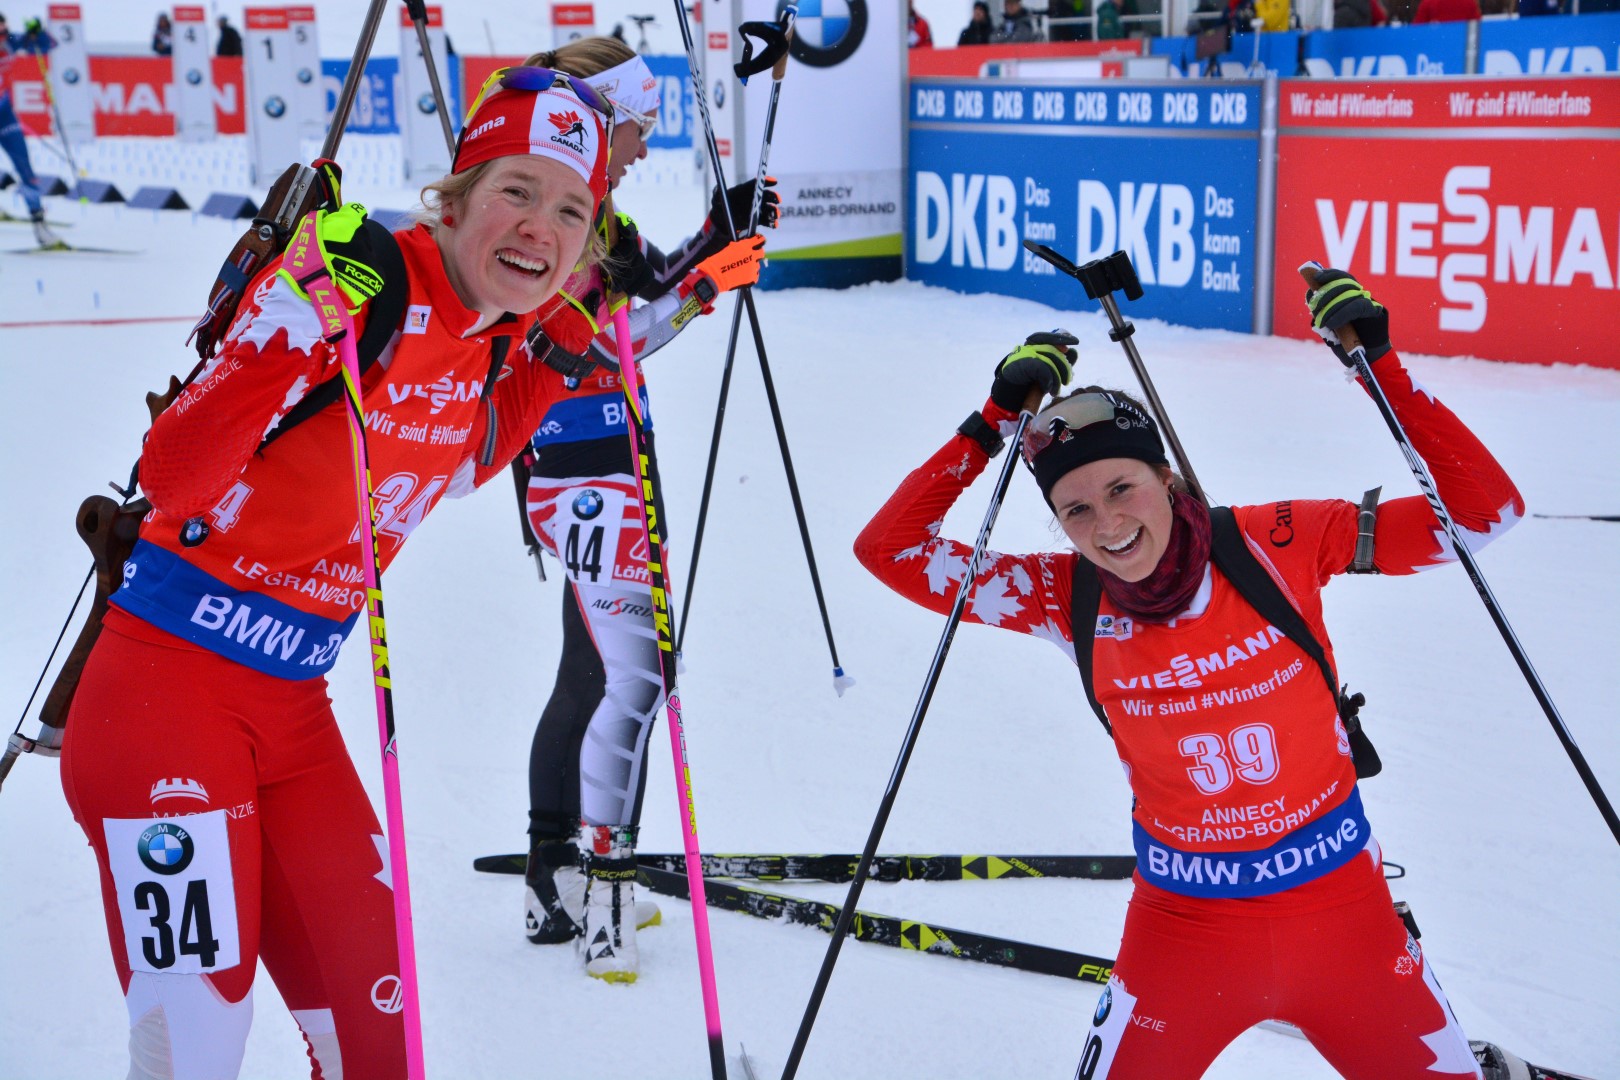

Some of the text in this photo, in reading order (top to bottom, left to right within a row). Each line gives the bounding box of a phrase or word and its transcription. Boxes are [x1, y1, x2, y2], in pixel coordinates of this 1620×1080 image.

[262, 37, 273, 60] 1
[917, 89, 1247, 124] DKB DKB DKB DKB DKB DKB DKB DKB
[1291, 93, 1413, 118] Wir sind #Winterfans
[1450, 91, 1591, 116] Wir sind #Winterfans
[550, 135, 584, 155] CANADA
[797, 186, 854, 200] ANNECY
[1024, 177, 1051, 207] Das
[1205, 185, 1234, 218] Das
[916, 170, 1018, 272] DKB
[1024, 210, 1056, 241] kann
[1077, 179, 1195, 288] DKB
[293, 218, 314, 268] LEKI
[1203, 222, 1241, 256] kann
[1315, 165, 1620, 334] VIESSMA
[720, 254, 753, 274] ziener
[1202, 261, 1241, 293] Bank
[314, 289, 342, 334] LEKI
[176, 356, 243, 417] MACKENZIE
[364, 410, 396, 436] Wir
[397, 421, 429, 443] sind
[1269, 500, 1294, 548] Can
[564, 523, 605, 583] 44
[646, 561, 674, 653] LEKI
[190, 593, 306, 663] BMW
[366, 586, 392, 690] LEKI
[1121, 657, 1304, 717] Wir sind #Winterfans
[1177, 722, 1281, 796] 39
[1201, 795, 1286, 825] ANNECY
[1148, 817, 1359, 885] BMW xDrive
[590, 868, 638, 879] FISCHER
[133, 878, 220, 970] 34
[1128, 1013, 1167, 1032] NZIE
